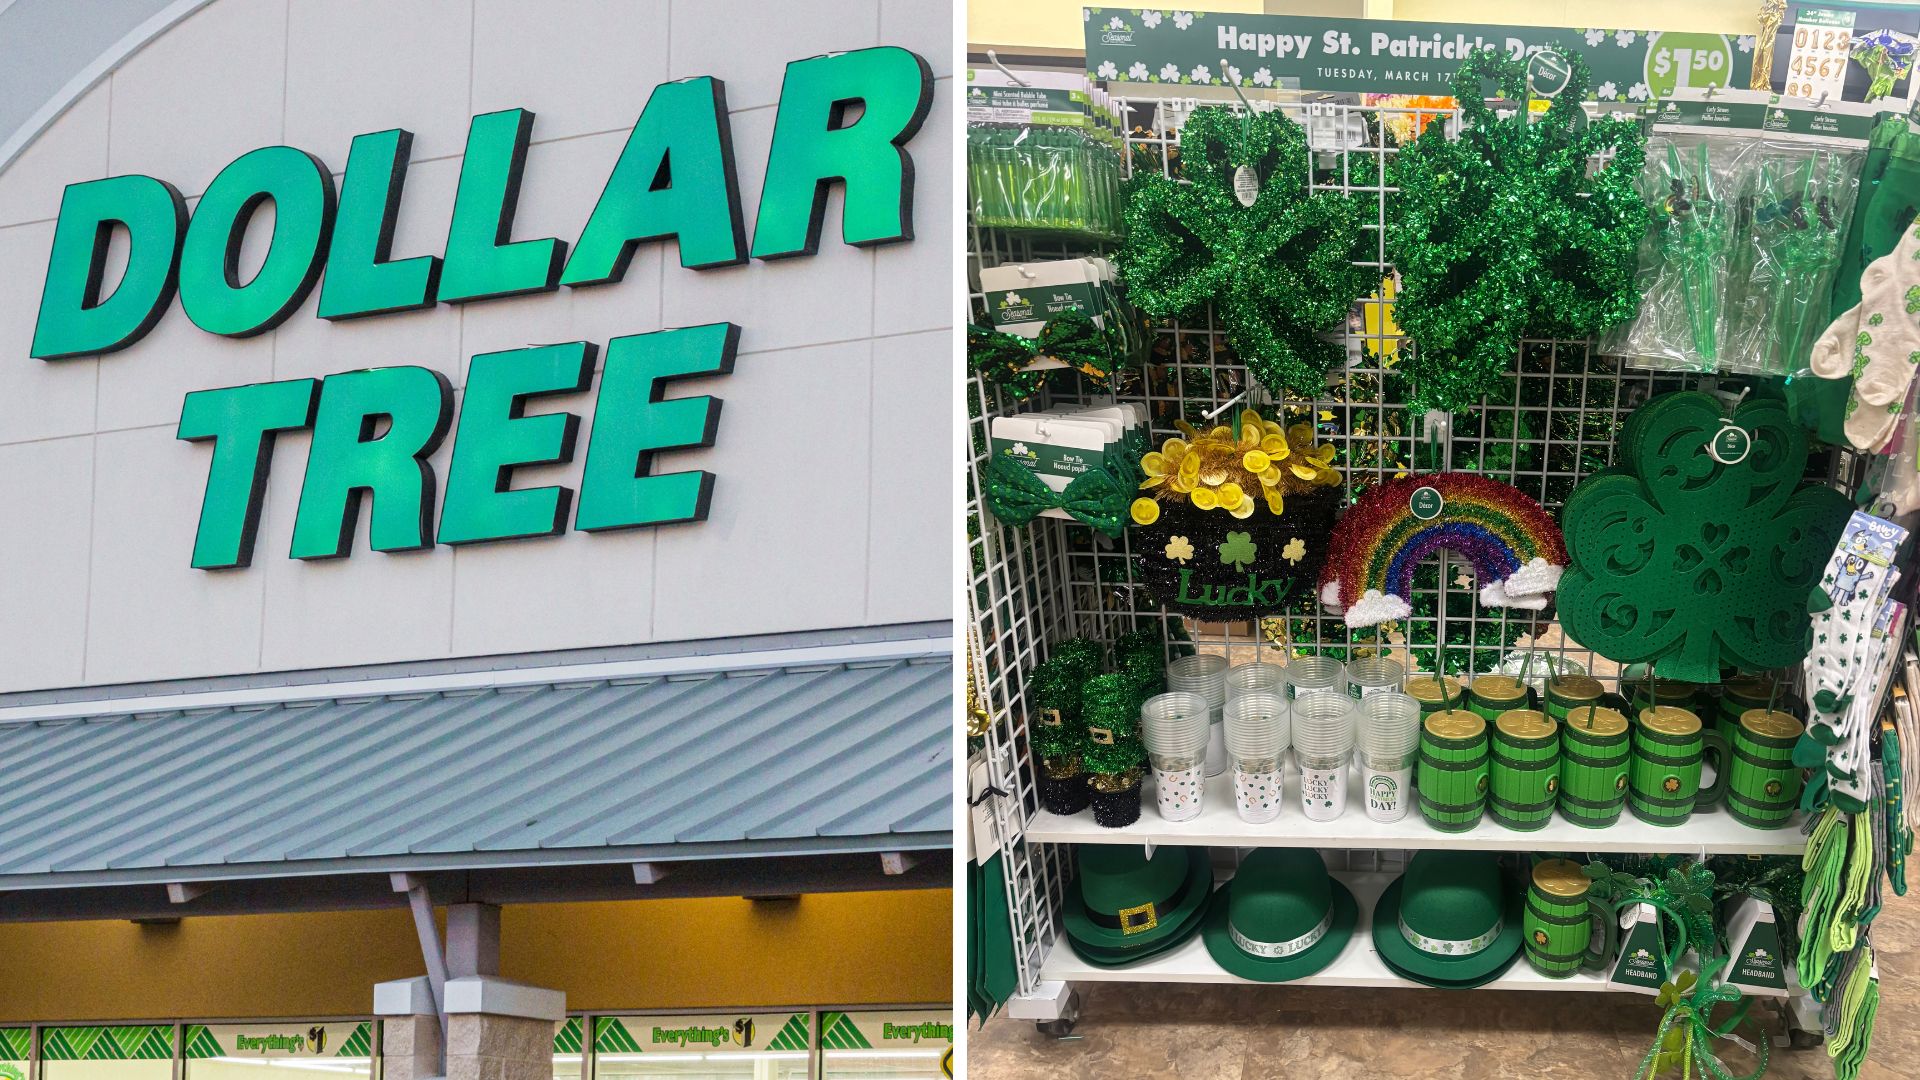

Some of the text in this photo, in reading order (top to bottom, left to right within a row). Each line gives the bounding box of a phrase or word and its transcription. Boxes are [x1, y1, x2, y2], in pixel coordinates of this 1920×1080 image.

[1217, 25, 1312, 59] Happy
[1323, 30, 1360, 56] St.
[1506, 37, 1552, 62] Da
[1317, 67, 1377, 81] TUESDAY,
[1384, 70, 1429, 82] MARCH
[1538, 66, 1557, 81] Décor
[30, 46, 935, 361] DOLLAR
[1002, 307, 1033, 320] Seasonal
[176, 322, 742, 570] TREE
[1063, 454, 1075, 462] Bow
[1418, 501, 1434, 509] Décor
[1175, 568, 1296, 606] Lucky
[1369, 787, 1397, 797] HAPPY
[1371, 799, 1397, 811] DAY!
[1235, 929, 1322, 954] LUCKY LUCKY
[1625, 968, 1658, 980] HEADBAND
[1742, 968, 1775, 979] HEADBAND
[236, 1034, 305, 1054] Everything's
[651, 1026, 730, 1047] Everything's
